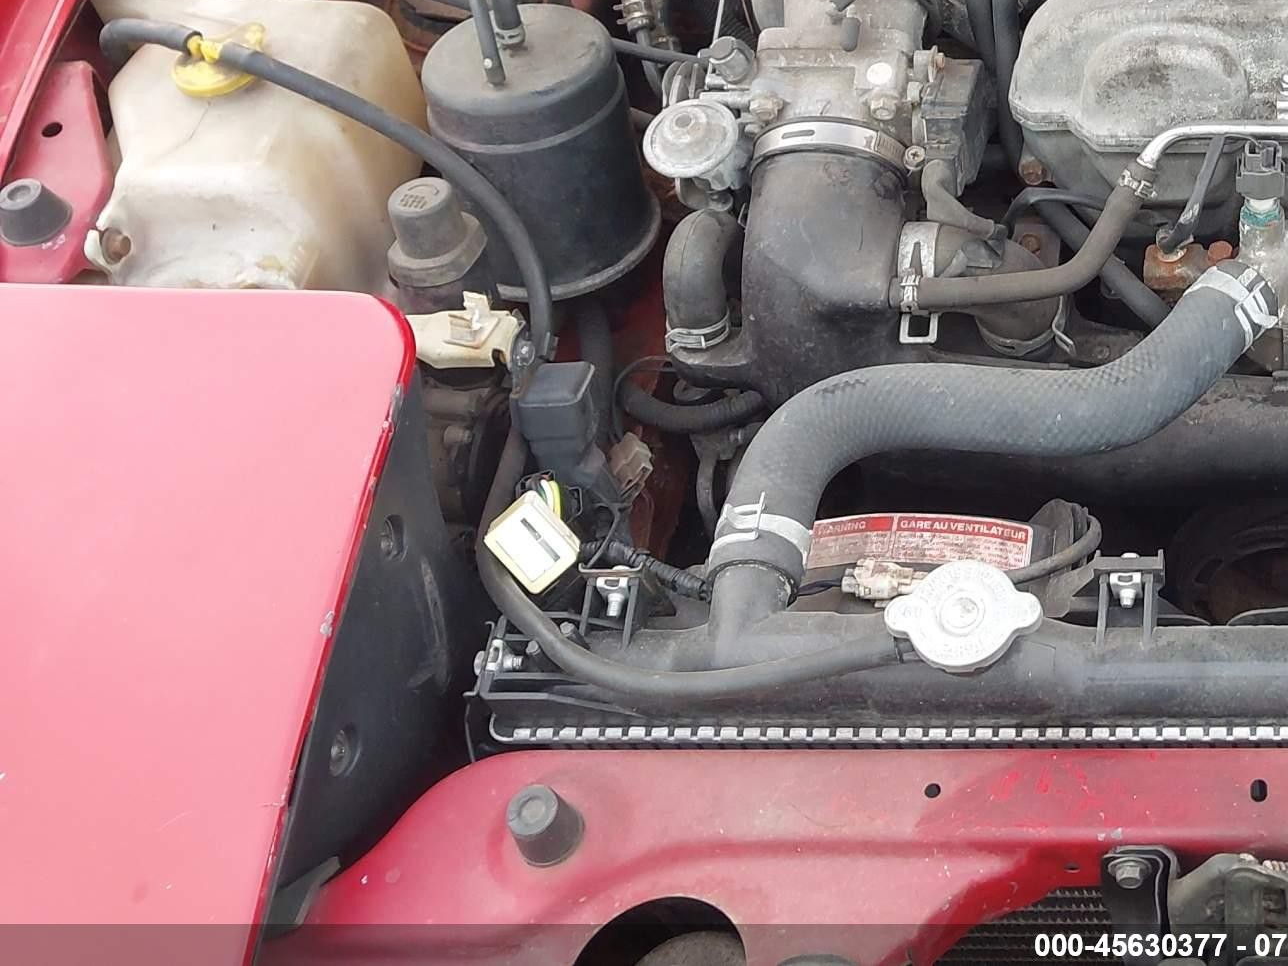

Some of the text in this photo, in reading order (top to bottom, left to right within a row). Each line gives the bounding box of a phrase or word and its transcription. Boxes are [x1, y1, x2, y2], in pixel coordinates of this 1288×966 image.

[817, 520, 866, 536] WARNING
[900, 520, 1027, 541] GARE AU VENTILATEUR
